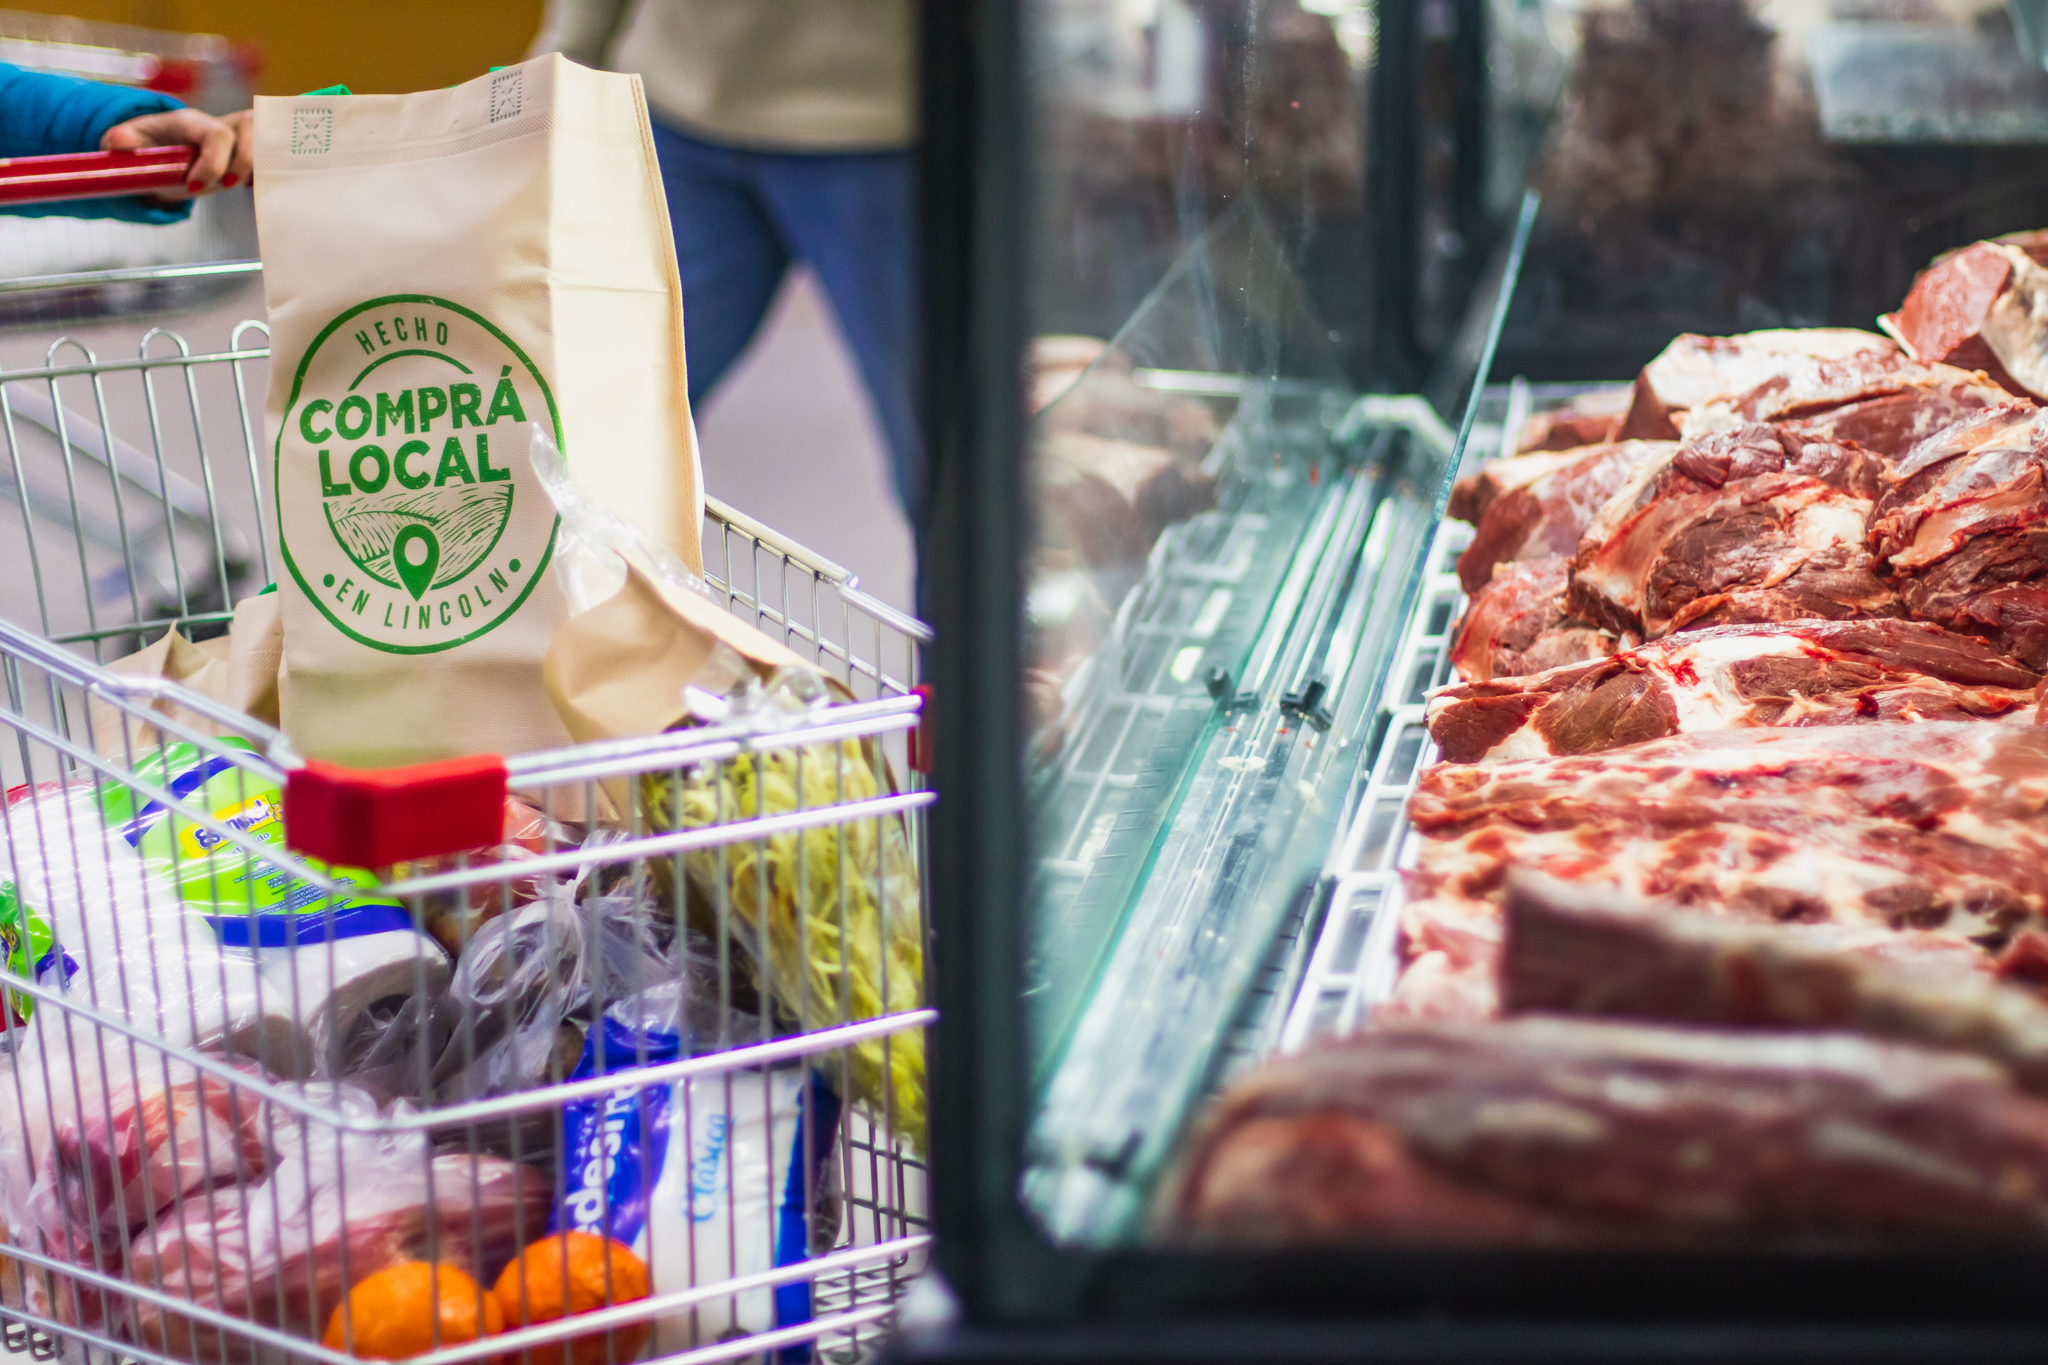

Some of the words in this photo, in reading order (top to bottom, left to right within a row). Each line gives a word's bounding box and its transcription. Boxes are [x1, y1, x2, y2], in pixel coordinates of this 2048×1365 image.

[354, 316, 449, 356] HECHO
[299, 364, 528, 445] COMPRÁ
[318, 433, 512, 498] LOCAL
[335, 577, 371, 616] EN
[383, 567, 510, 630] LINCOLN
